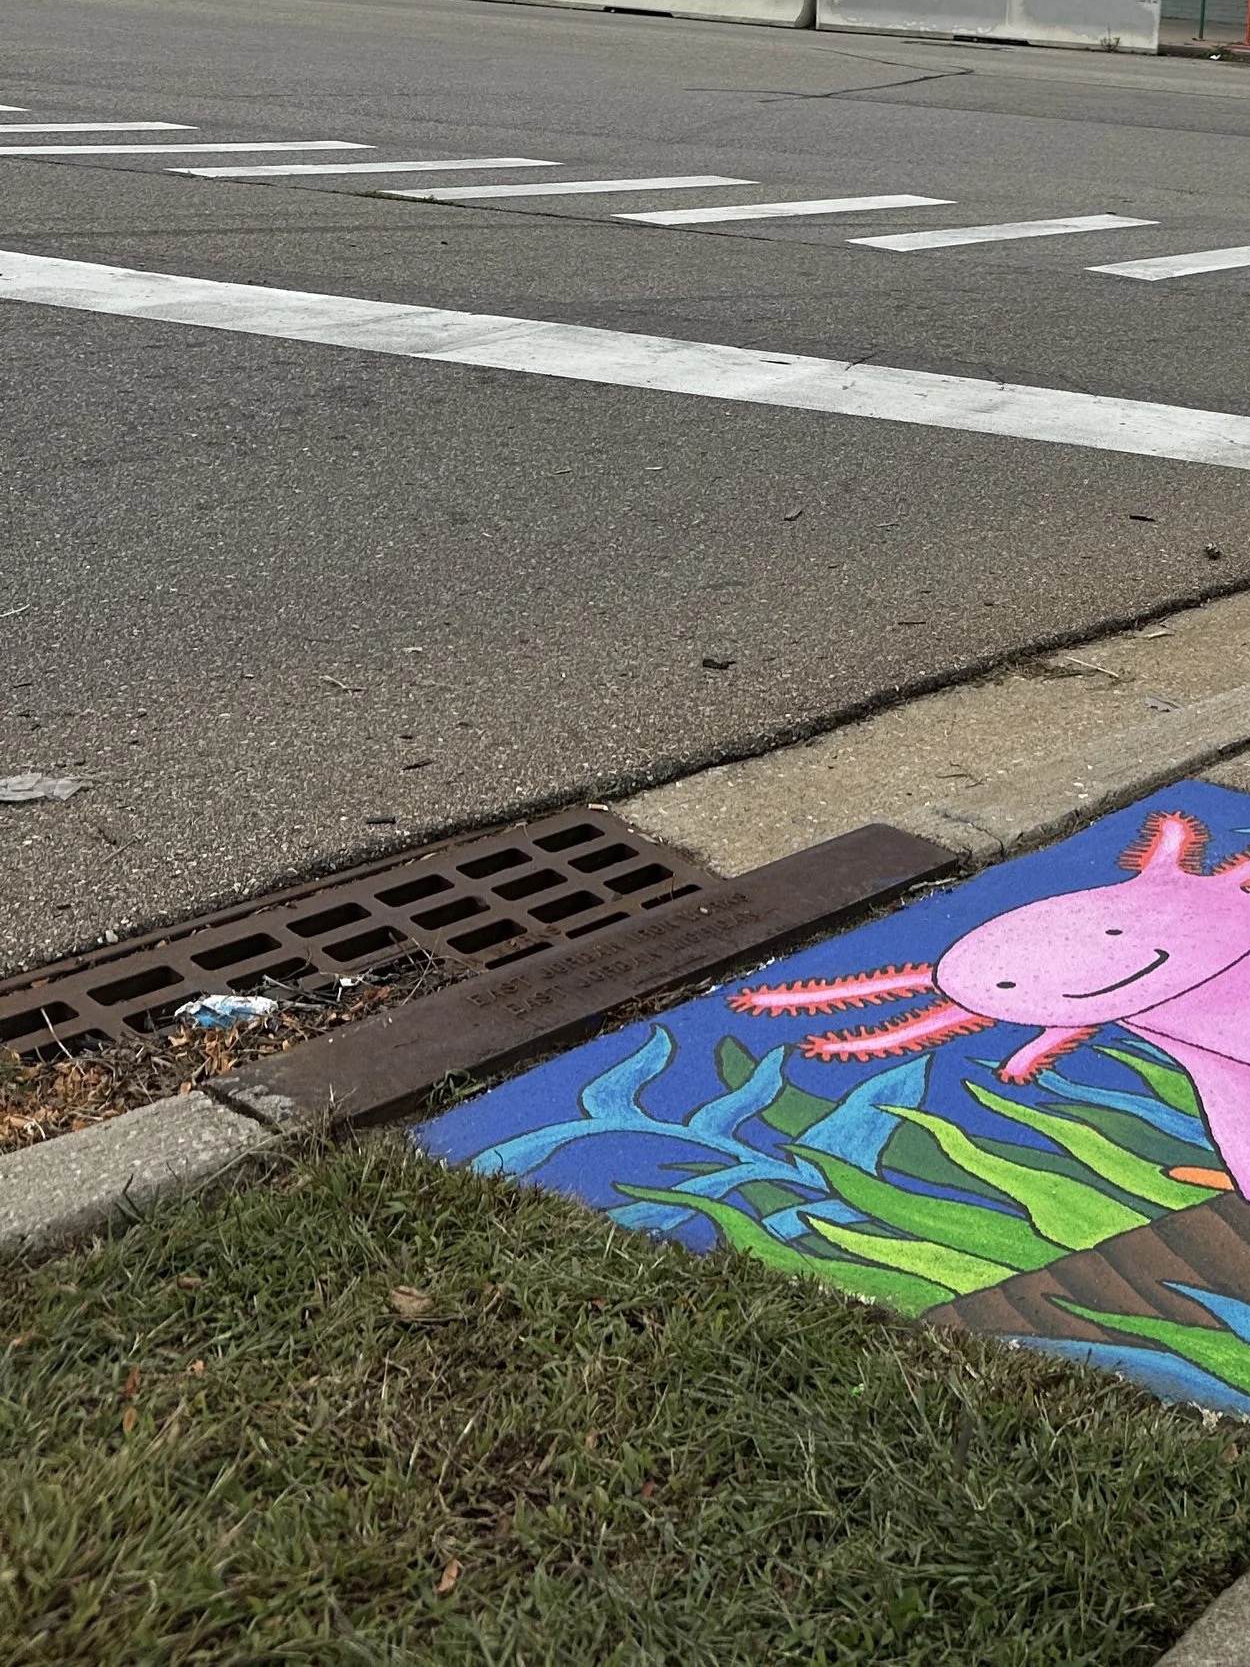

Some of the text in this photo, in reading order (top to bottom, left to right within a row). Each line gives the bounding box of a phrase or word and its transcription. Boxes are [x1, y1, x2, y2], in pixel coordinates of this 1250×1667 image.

[467, 974, 534, 1007] EAST
[543, 939, 622, 980] JORDAN
[625, 918, 679, 949] IRON
[504, 985, 567, 1017] EAST
[576, 947, 664, 988] JORDAN
